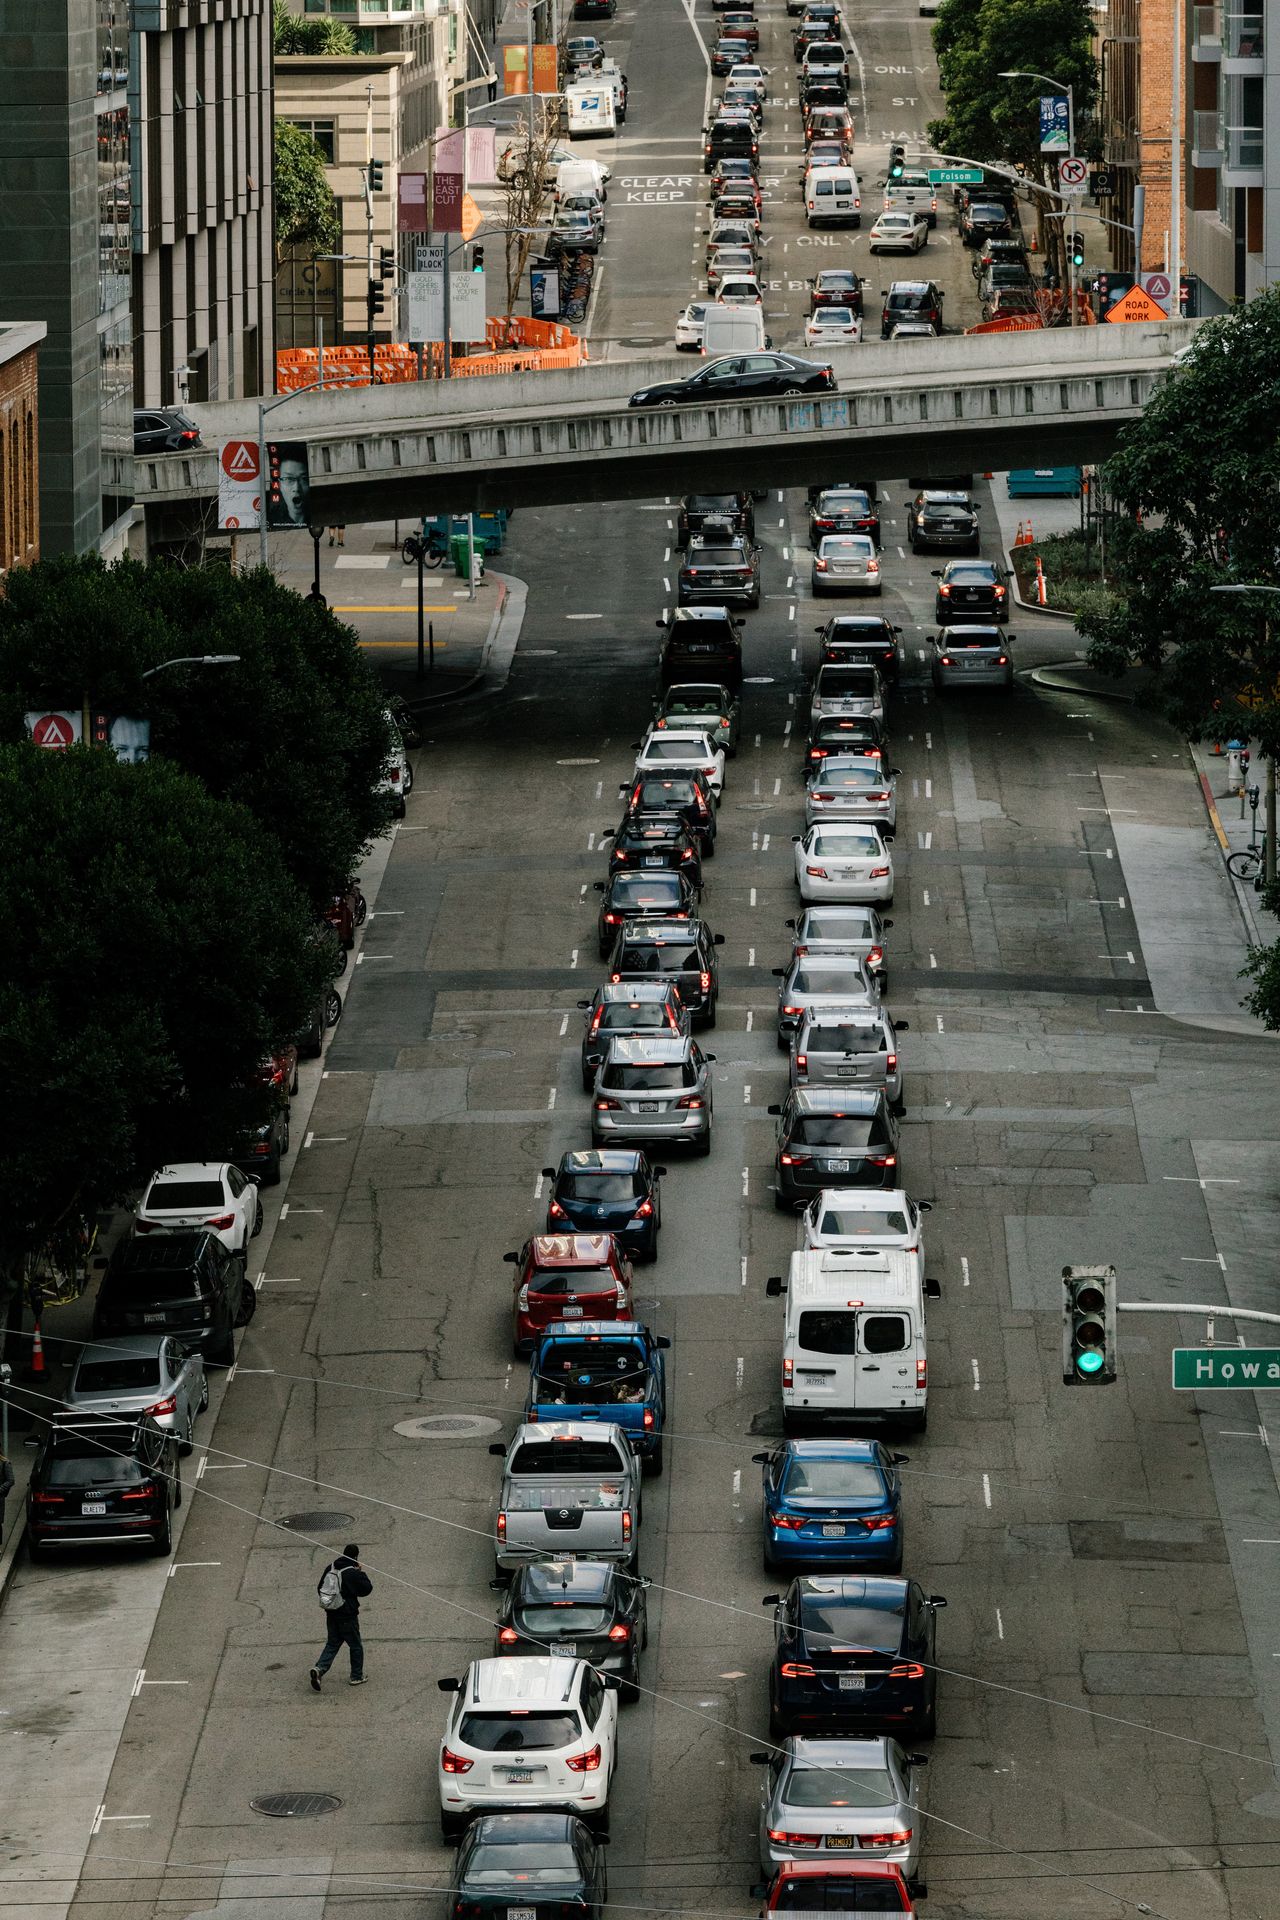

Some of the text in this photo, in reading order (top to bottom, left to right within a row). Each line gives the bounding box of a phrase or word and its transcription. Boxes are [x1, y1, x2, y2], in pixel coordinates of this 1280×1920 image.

[874, 66, 929, 74] ONLY
[892, 98, 918, 106] ST
[435, 176, 455, 184] THE
[940, 172, 972, 180] Folsom
[620, 177, 692, 188] CLEAR
[435, 186, 460, 195] EAST
[435, 196, 456, 205] CUT
[627, 191, 685, 202] KEEP
[796, 235, 862, 246] ONLY
[417, 249, 444, 257] DO NOT
[1125, 301, 1149, 309] ROAD
[1124, 313, 1150, 321] WORK
[270, 446, 280, 502] DREAM
[1196, 1359, 1280, 1379] Howa
